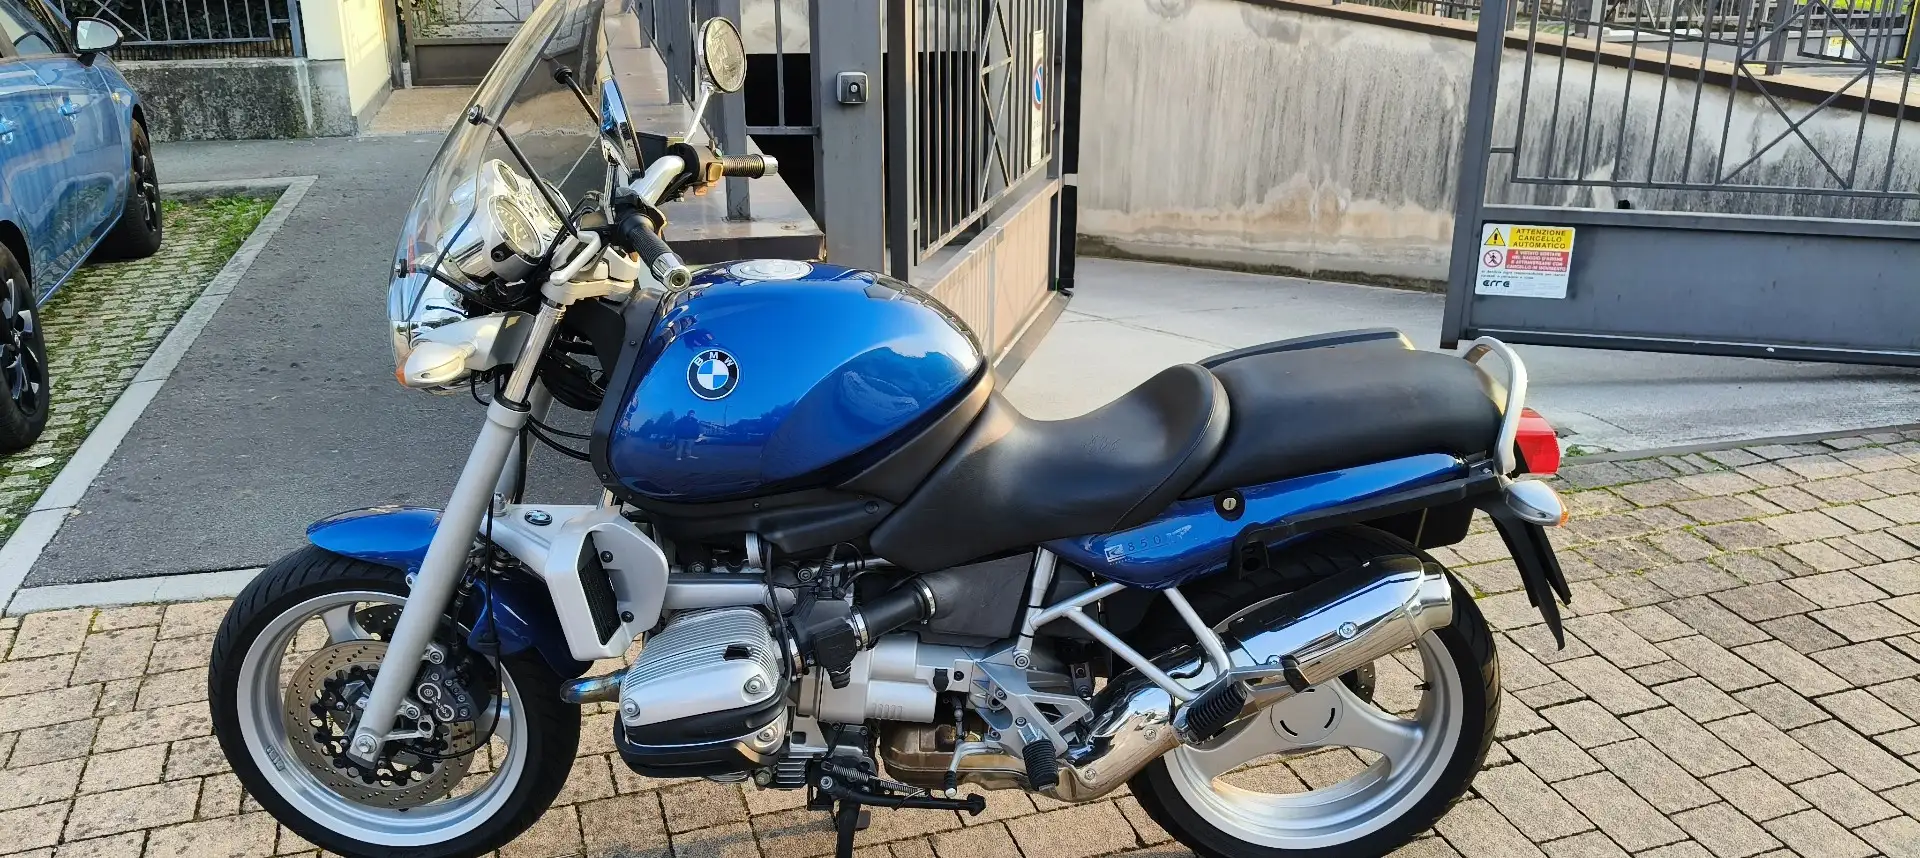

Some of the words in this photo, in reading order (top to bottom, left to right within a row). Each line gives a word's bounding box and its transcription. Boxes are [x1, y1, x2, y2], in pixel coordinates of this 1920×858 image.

[1516, 228, 1566, 236] ATTENZIONE
[1518, 235, 1562, 243] CANCELLO
[1512, 241, 1566, 249] AUTOMATICO
[693, 351, 735, 367] BMW
[1127, 535, 1162, 552] 850
